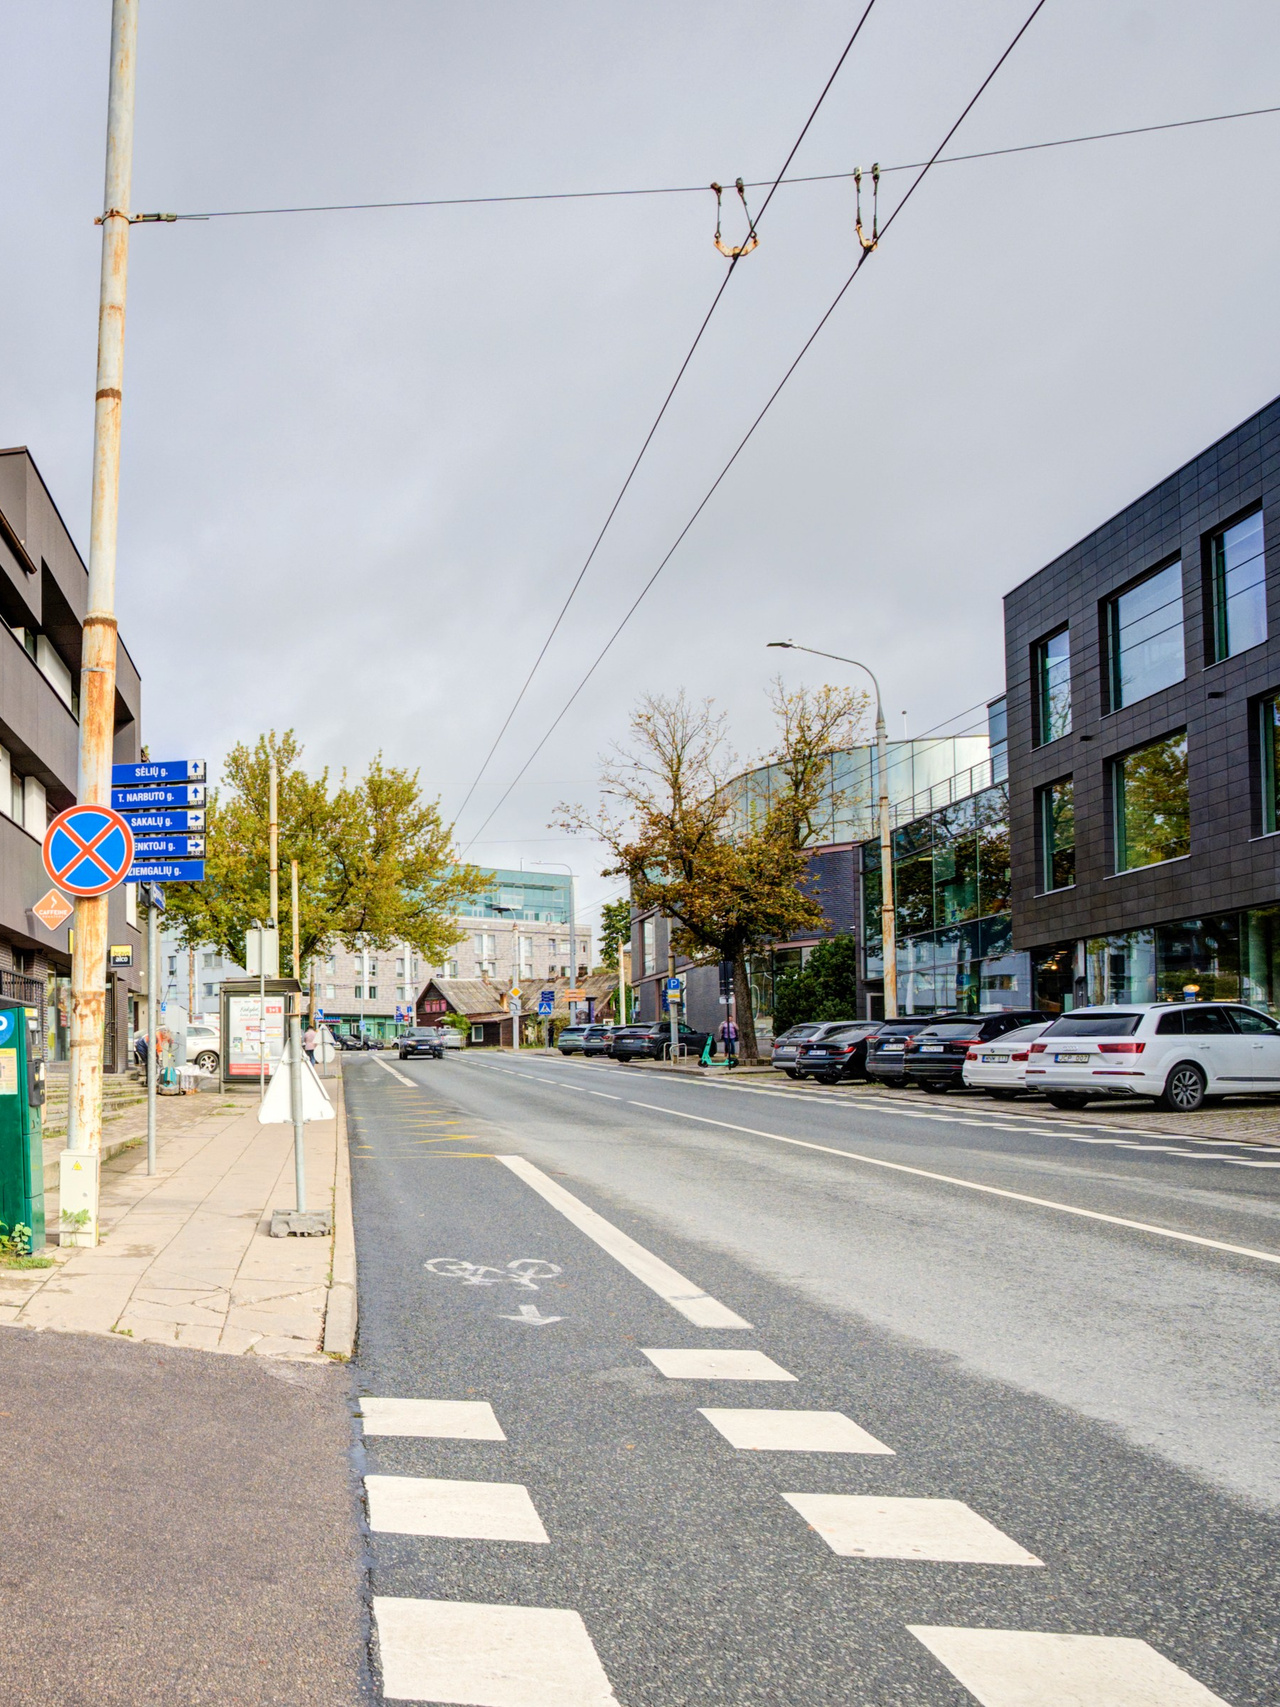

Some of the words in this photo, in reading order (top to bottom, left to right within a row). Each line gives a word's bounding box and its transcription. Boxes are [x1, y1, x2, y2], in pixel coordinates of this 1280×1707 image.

[135, 766, 158, 777] SĖLIŲ
[160, 768, 168, 777] g.
[118, 793, 125, 803] T.
[126, 791, 165, 802] NARBUTO
[131, 816, 163, 828] SAKALŲ
[165, 818, 173, 827] g.
[168, 842, 176, 851] g.
[173, 867, 181, 876] g.
[670, 979, 678, 988] P
